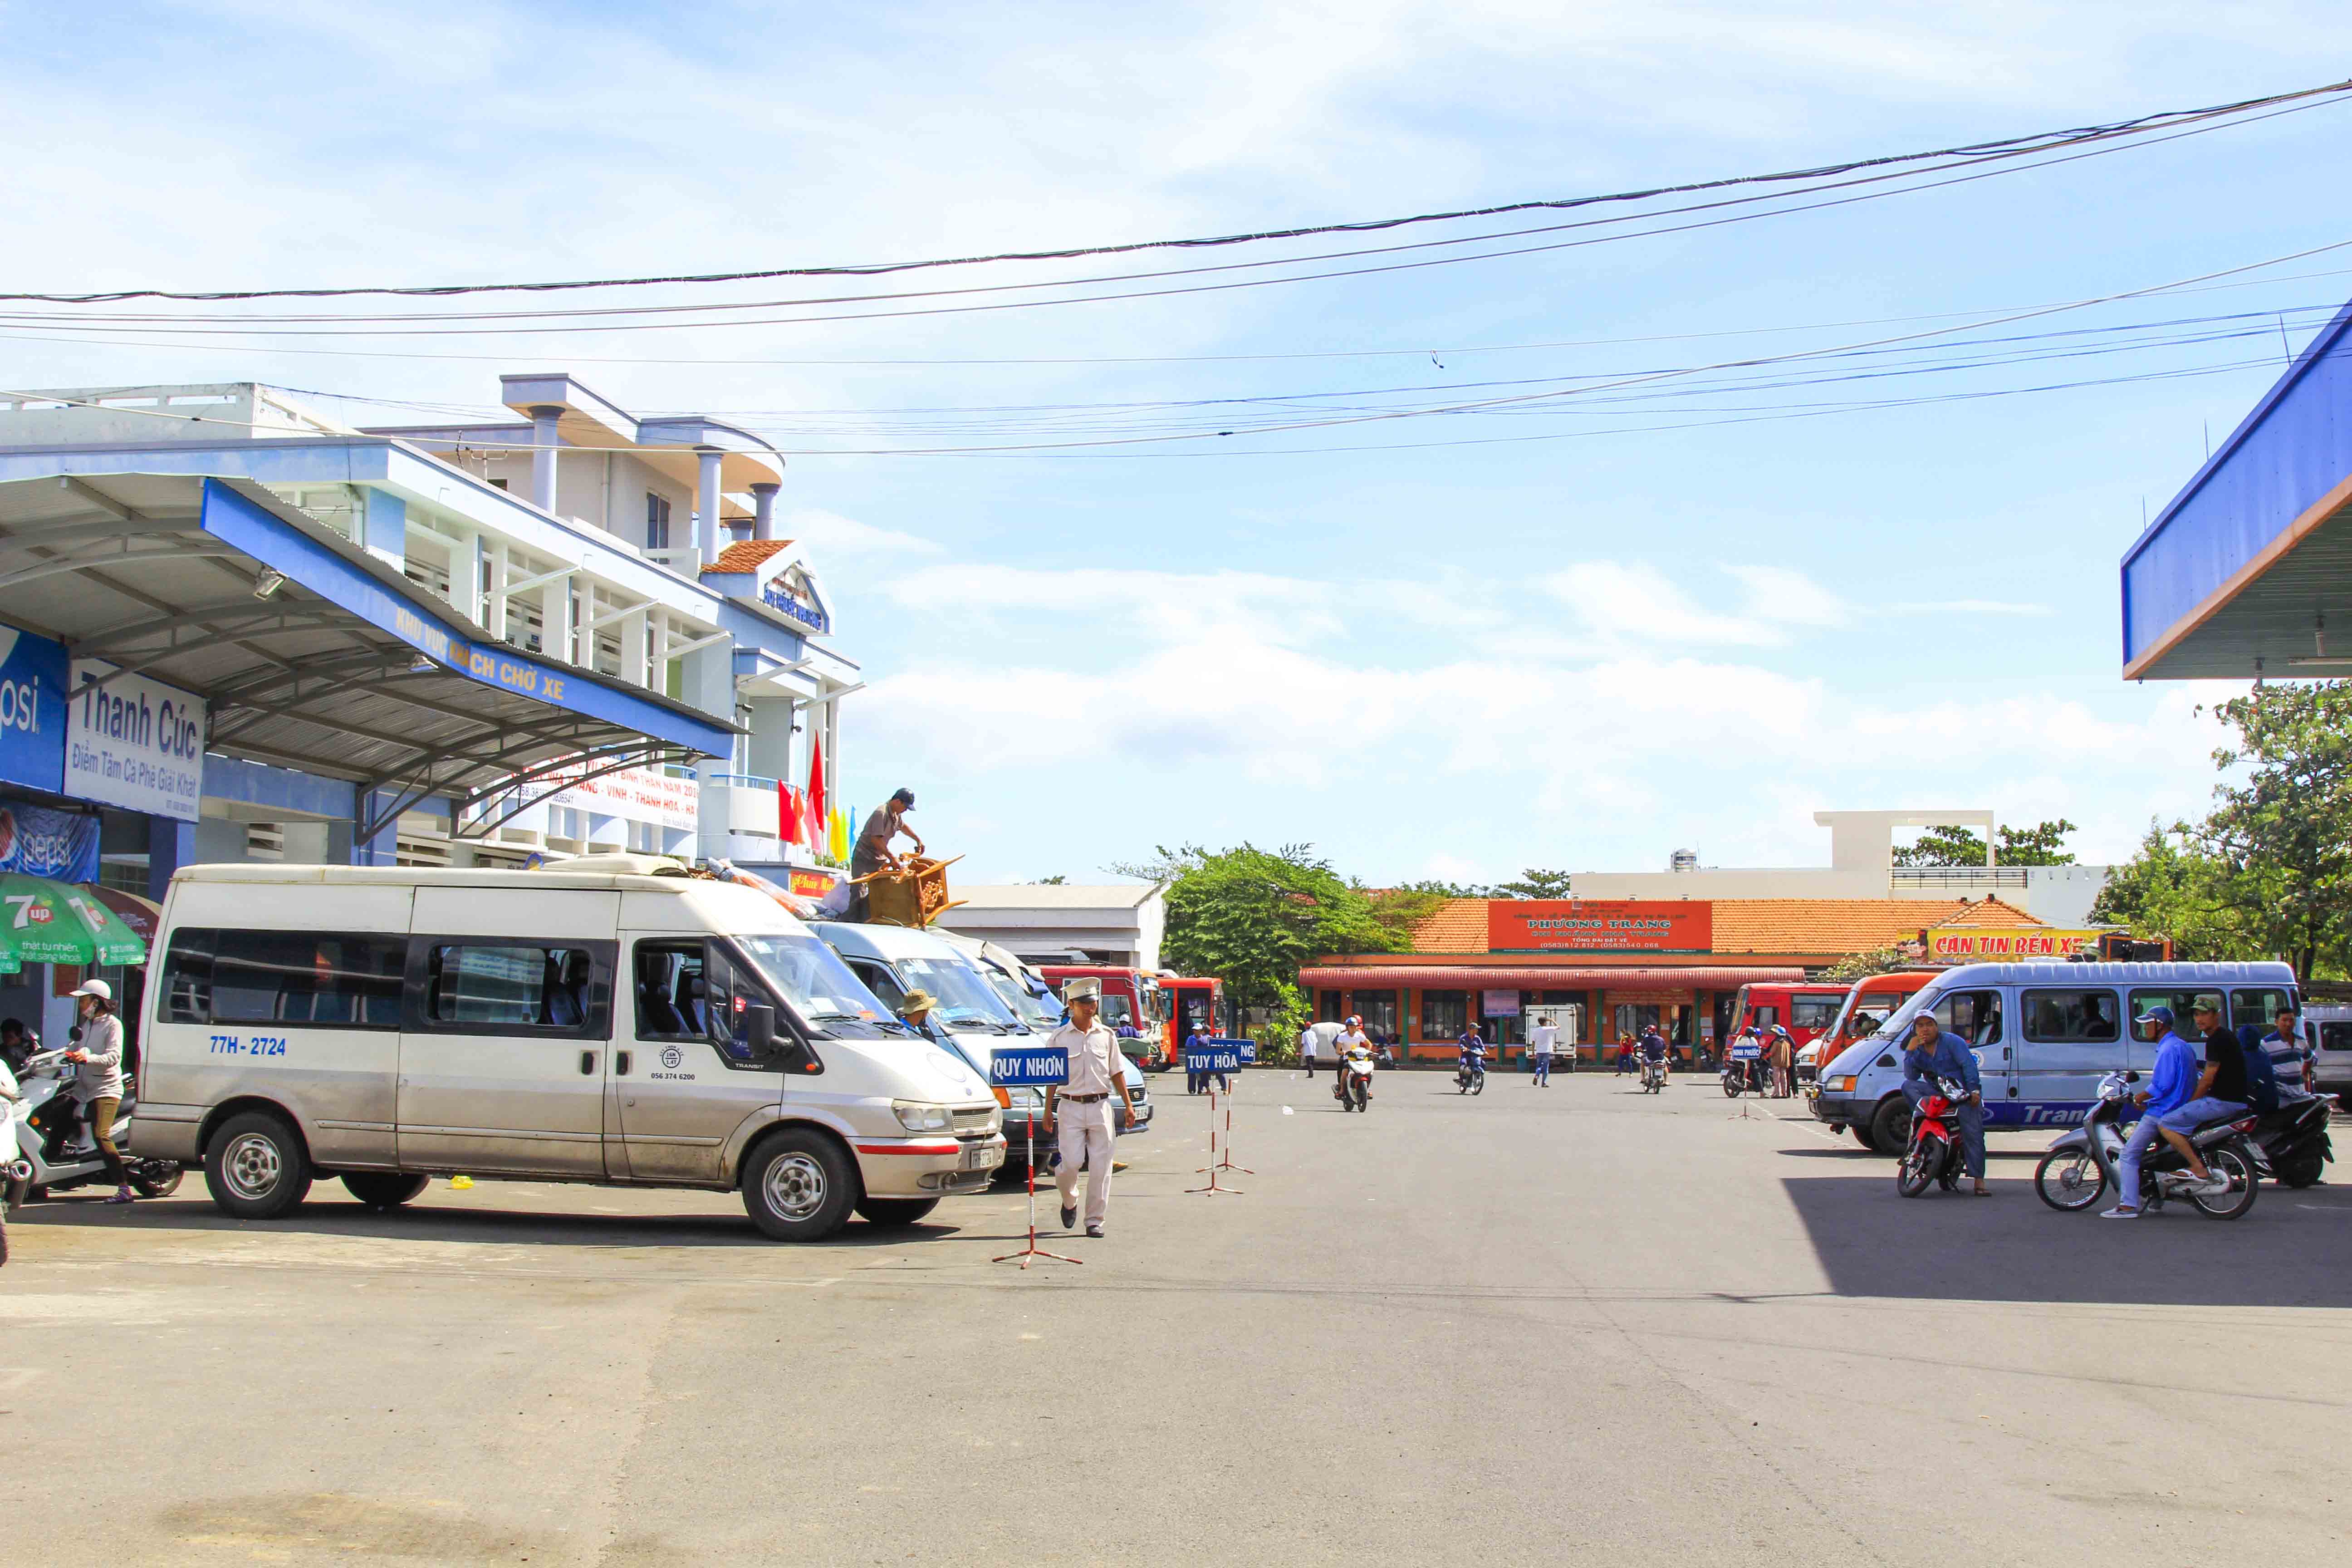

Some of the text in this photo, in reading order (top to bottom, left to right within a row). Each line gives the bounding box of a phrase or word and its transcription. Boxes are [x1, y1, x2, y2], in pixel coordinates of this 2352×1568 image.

[396, 606, 422, 641] KHU
[500, 662, 537, 691] CHỜ
[542, 676, 564, 701] XE
[82, 670, 197, 760] Thanh Cúc
[102, 750, 122, 779] Tâm
[607, 785, 627, 801] VINH
[635, 791, 662, 808] THANH
[1607, 919, 1671, 929] TRANG
[1979, 936, 2011, 955] TIN
[2014, 931, 2054, 956] BẾN
[2058, 936, 2085, 955] XE
[994, 1055, 1064, 1080] QUY NHƠN
[1188, 1051, 1238, 1068] TUY HÒA
